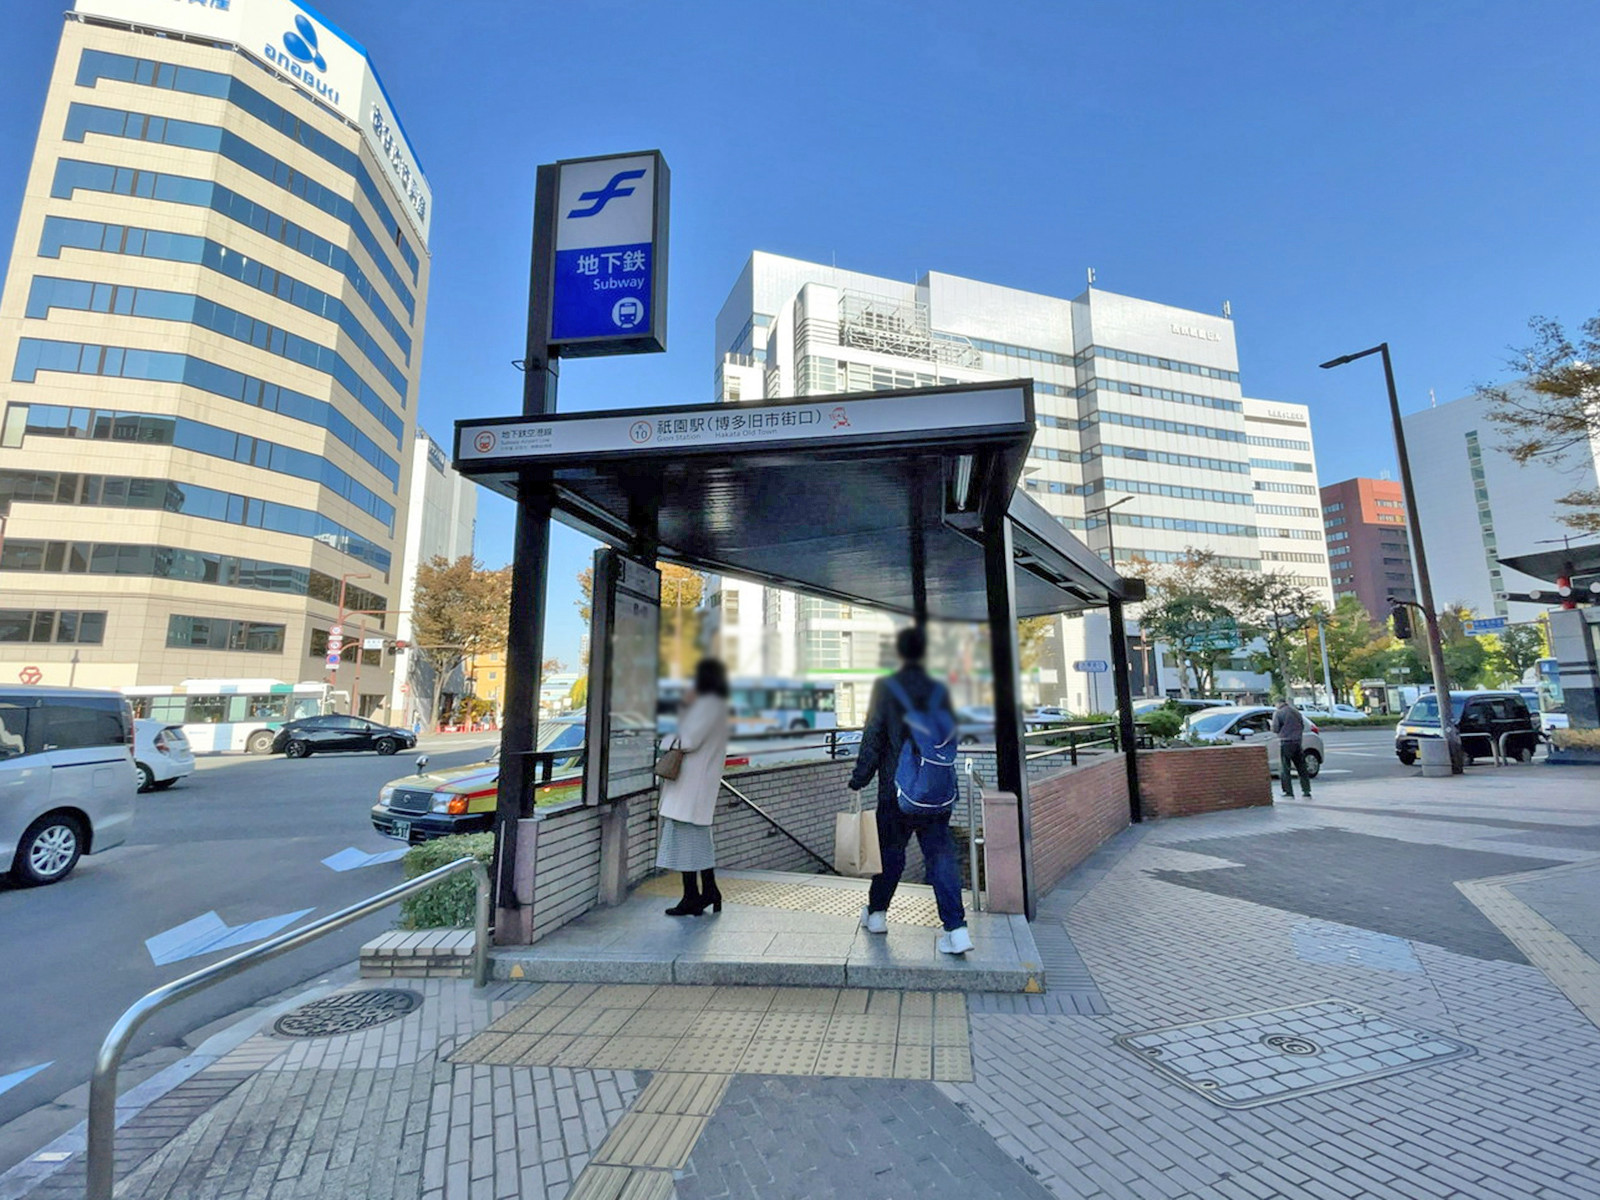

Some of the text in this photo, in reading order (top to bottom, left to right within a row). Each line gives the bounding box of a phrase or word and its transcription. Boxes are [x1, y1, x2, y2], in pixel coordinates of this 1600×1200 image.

[576, 249, 646, 275] 地下鉄
[593, 277, 645, 290] Subway
[634, 430, 648, 439] 10
[676, 433, 702, 441] Station
[715, 428, 778, 438] Hakata Old Town
